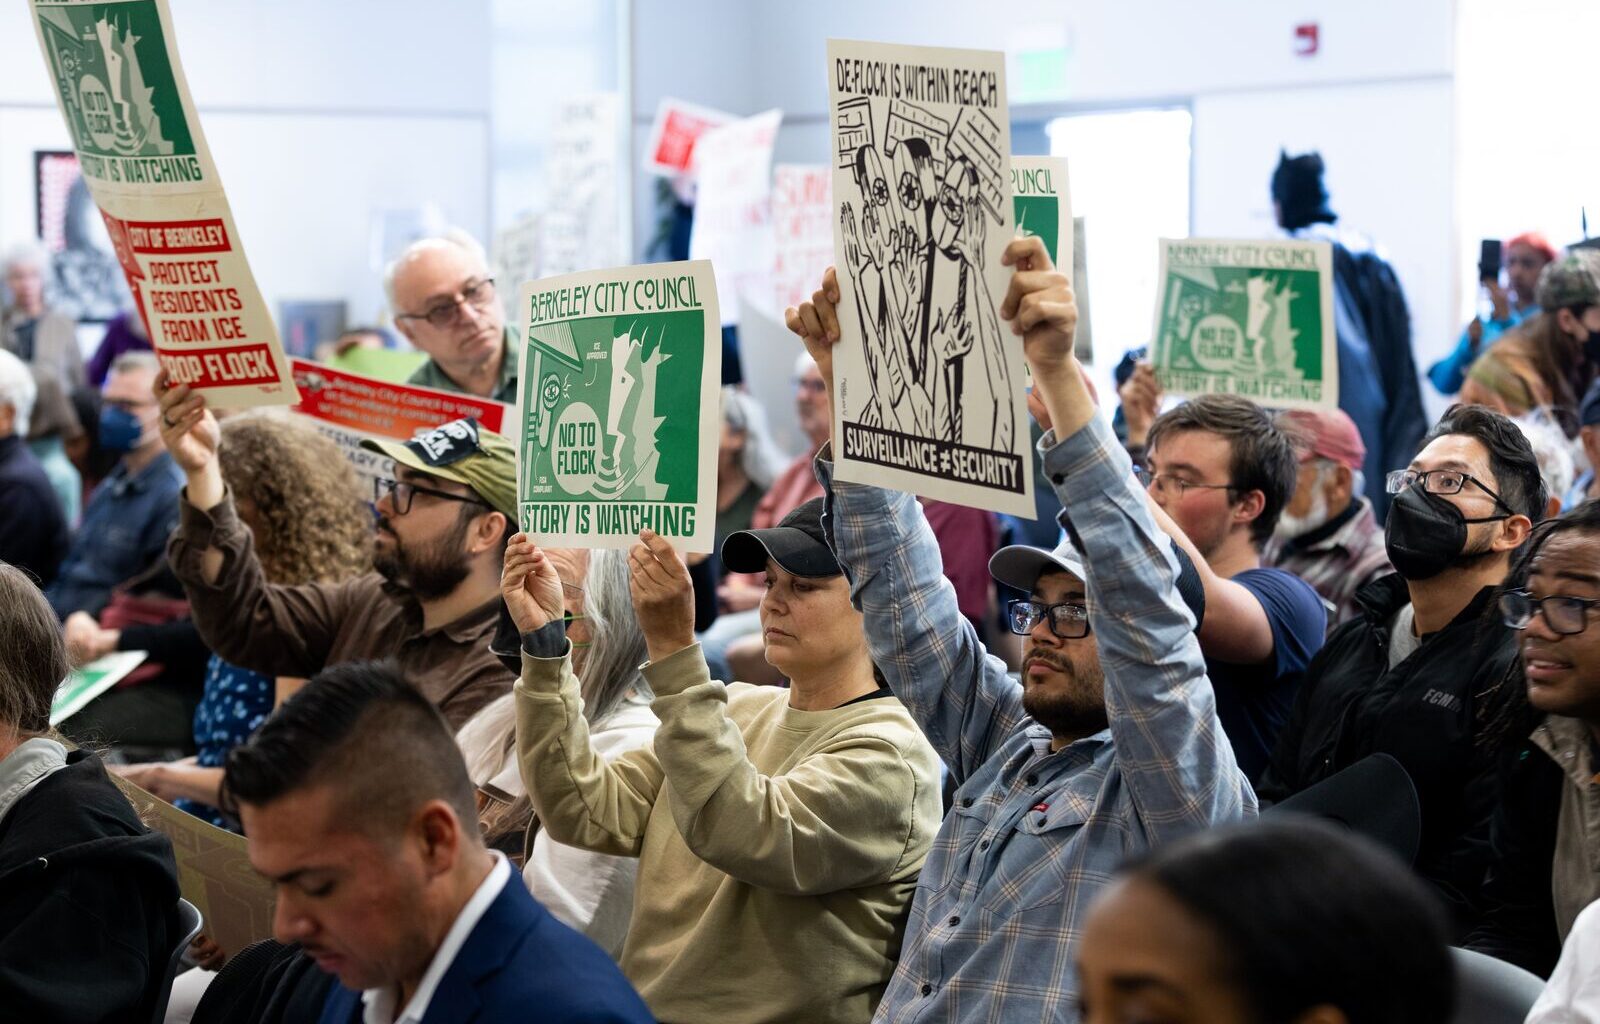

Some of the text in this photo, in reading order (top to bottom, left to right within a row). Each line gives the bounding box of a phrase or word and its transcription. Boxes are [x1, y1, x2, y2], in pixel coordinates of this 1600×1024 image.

[836, 58, 997, 108] DE-FLOCK IS WITHIN REACH
[120, 157, 203, 183] WATCHING
[149, 228, 164, 248] OF
[164, 226, 225, 248] BERKELEY
[149, 260, 221, 284] PROTECT
[150, 288, 242, 314] RESIDENTS
[530, 276, 702, 322] BERKELEY CITY COUNCIL
[161, 317, 247, 342] FROM ICE
[203, 350, 275, 381] FLOCK
[558, 422, 596, 448] NO TO
[558, 450, 596, 475] FLOCK
[846, 427, 938, 472] SURVEILLANCE
[952, 449, 1018, 488] SECURITY
[576, 504, 590, 534] IS
[596, 504, 696, 537] WATCHING
